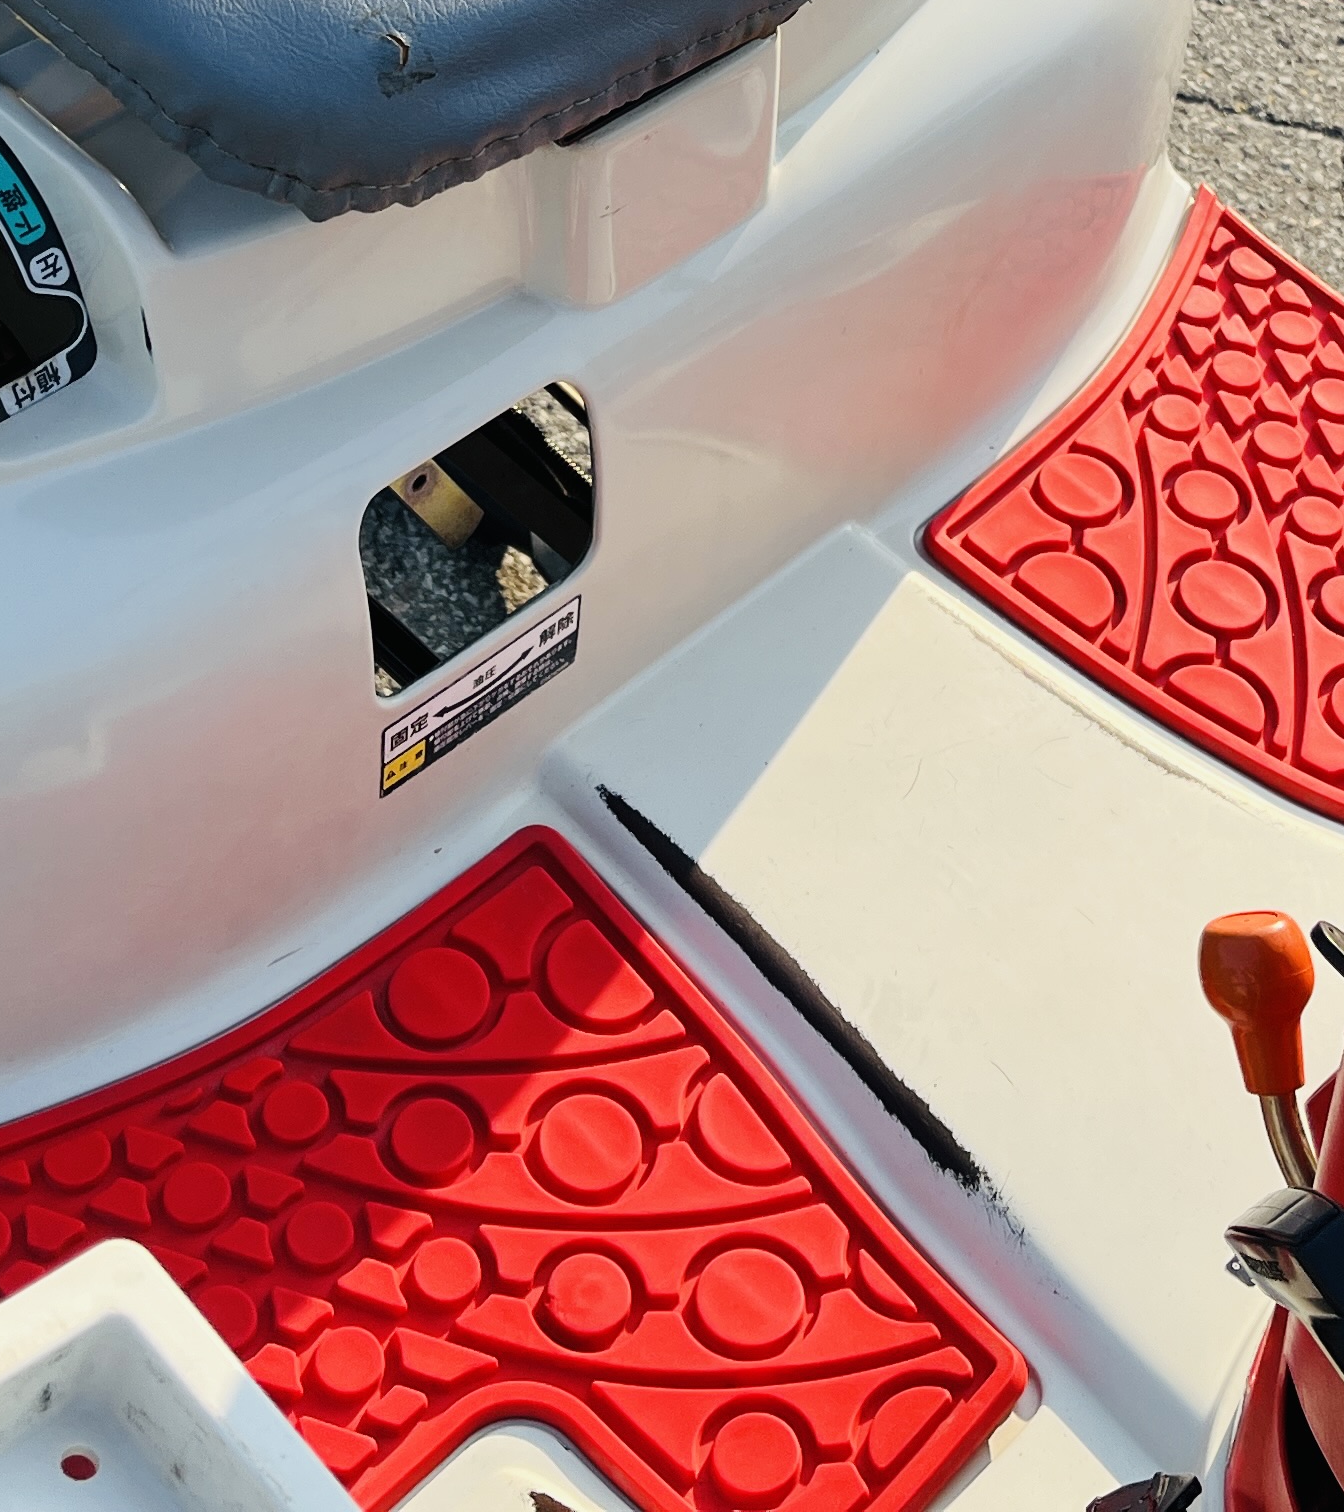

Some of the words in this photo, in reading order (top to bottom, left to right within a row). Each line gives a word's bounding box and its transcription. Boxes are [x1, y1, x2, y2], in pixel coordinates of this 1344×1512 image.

[36, 253, 63, 281] 左
[11, 361, 61, 409] 植付
[390, 712, 429, 752] 固定
[538, 611, 575, 648] 解除
